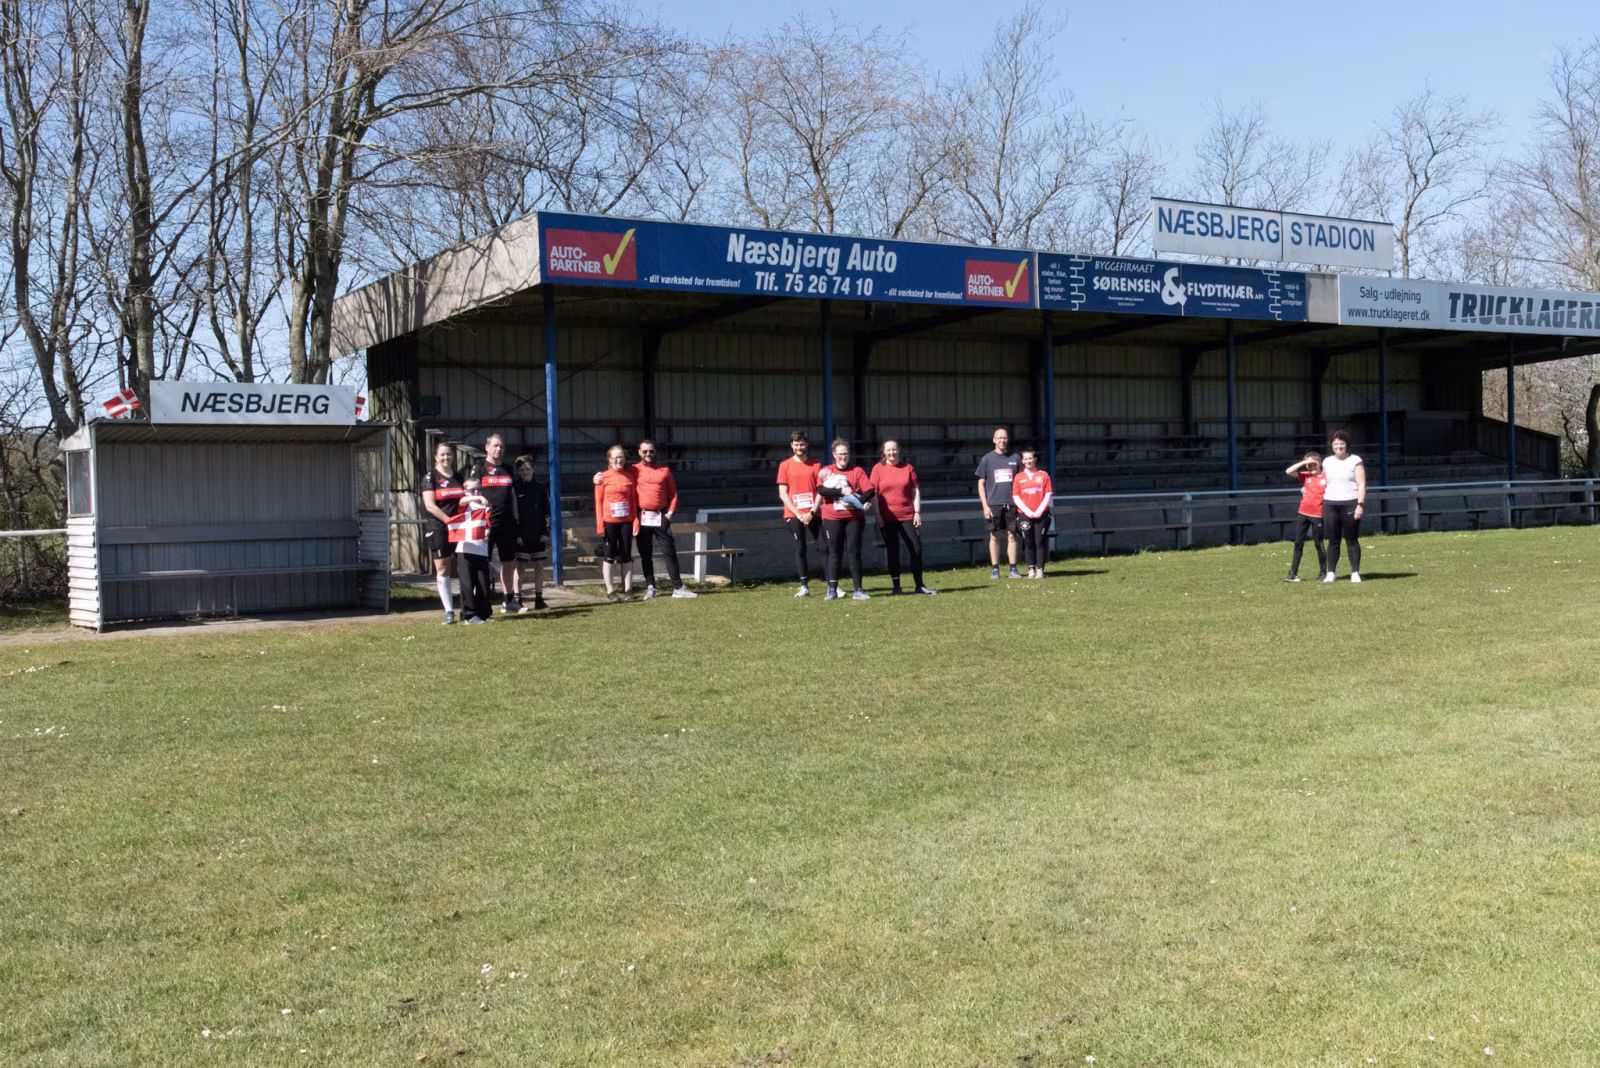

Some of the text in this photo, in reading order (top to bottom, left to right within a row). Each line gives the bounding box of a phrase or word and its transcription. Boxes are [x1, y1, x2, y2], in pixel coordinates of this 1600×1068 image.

[1158, 206, 1375, 252] NÆSBJERG STADION
[727, 233, 897, 275] Næsbjerg Auto
[550, 260, 601, 274] PARTNER
[1095, 260, 1155, 273] BYGGEFIRMAET
[649, 274, 660, 284] dit
[661, 275, 693, 286] værksted
[694, 277, 705, 286] for
[705, 278, 741, 288] fremtiden!
[755, 271, 874, 296] Tlf. 75 26 74 10
[1093, 275, 1161, 293] SØRENSEN
[1161, 267, 1187, 305] &
[1187, 282, 1254, 300] FLYDTKJÆR
[898, 289, 925, 298] værksted
[925, 290, 933, 298] for
[967, 285, 1004, 298] PARTNER
[1360, 286, 1379, 301] Salg
[1384, 290, 1422, 304] udlejning
[1347, 306, 1431, 322] www.trucklageret.dk
[181, 392, 330, 415] NÆSBJERG
